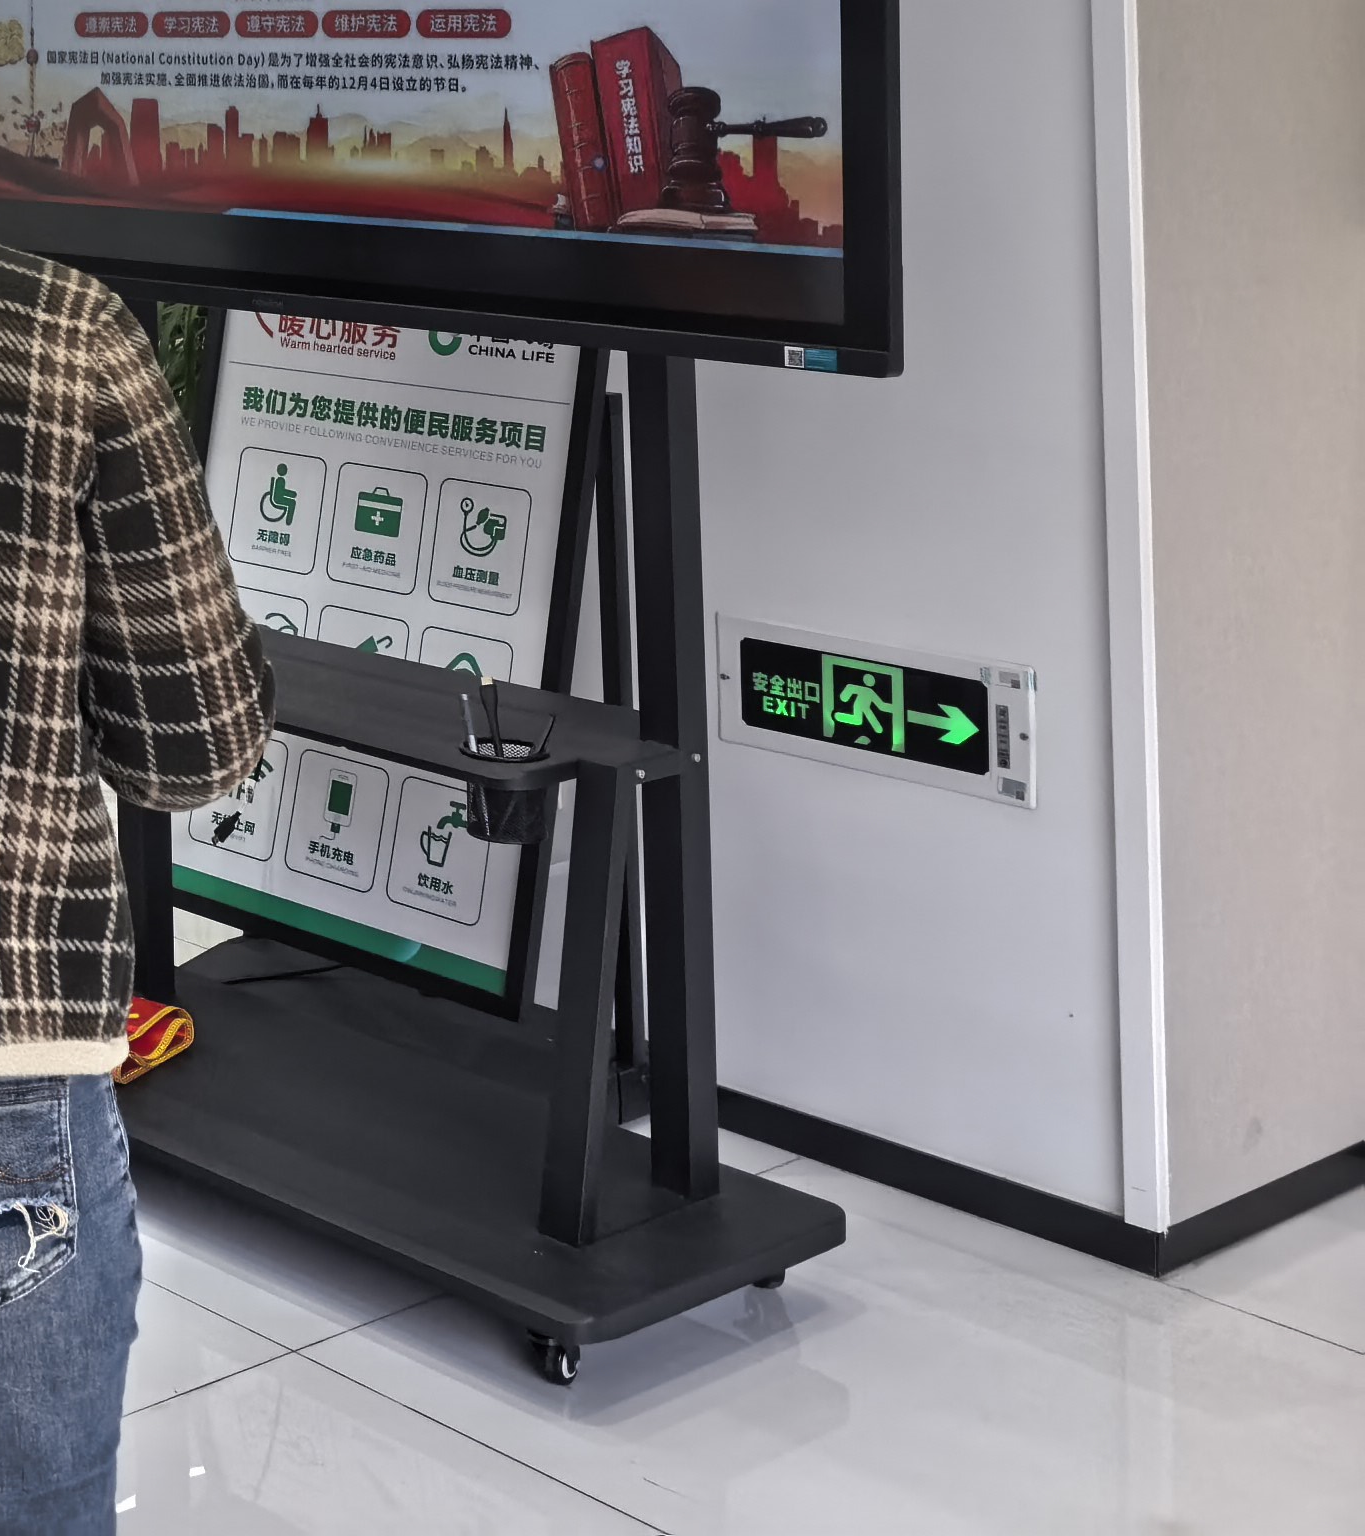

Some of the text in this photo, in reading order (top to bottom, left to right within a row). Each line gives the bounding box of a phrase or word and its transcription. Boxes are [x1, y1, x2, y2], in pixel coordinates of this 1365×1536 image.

[164, 15, 219, 33] 学习宪法
[247, 15, 305, 33] 遵守宪法
[335, 14, 398, 32] 维护宪法
[430, 14, 498, 32] 运用宪法
[158, 53, 234, 67] Constitution
[615, 59, 645, 174] 学习宪法知识
[280, 335, 396, 361] Warm hearted service
[468, 344, 556, 364] CHINA LIFE
[242, 386, 547, 453] 我们为您提供的便民服务项目
[241, 416, 543, 469] WE PROVIDE FOLLOWING CONVENIENCE SERVICES FOR YOU
[350, 546, 397, 567] 应急药品
[452, 565, 500, 586] 血压测量
[752, 670, 820, 704] 安全出口
[762, 695, 810, 720] EXIT
[211, 811, 256, 836] 无上网
[308, 840, 355, 866] 手机充电
[417, 872, 454, 896] 饮用水
